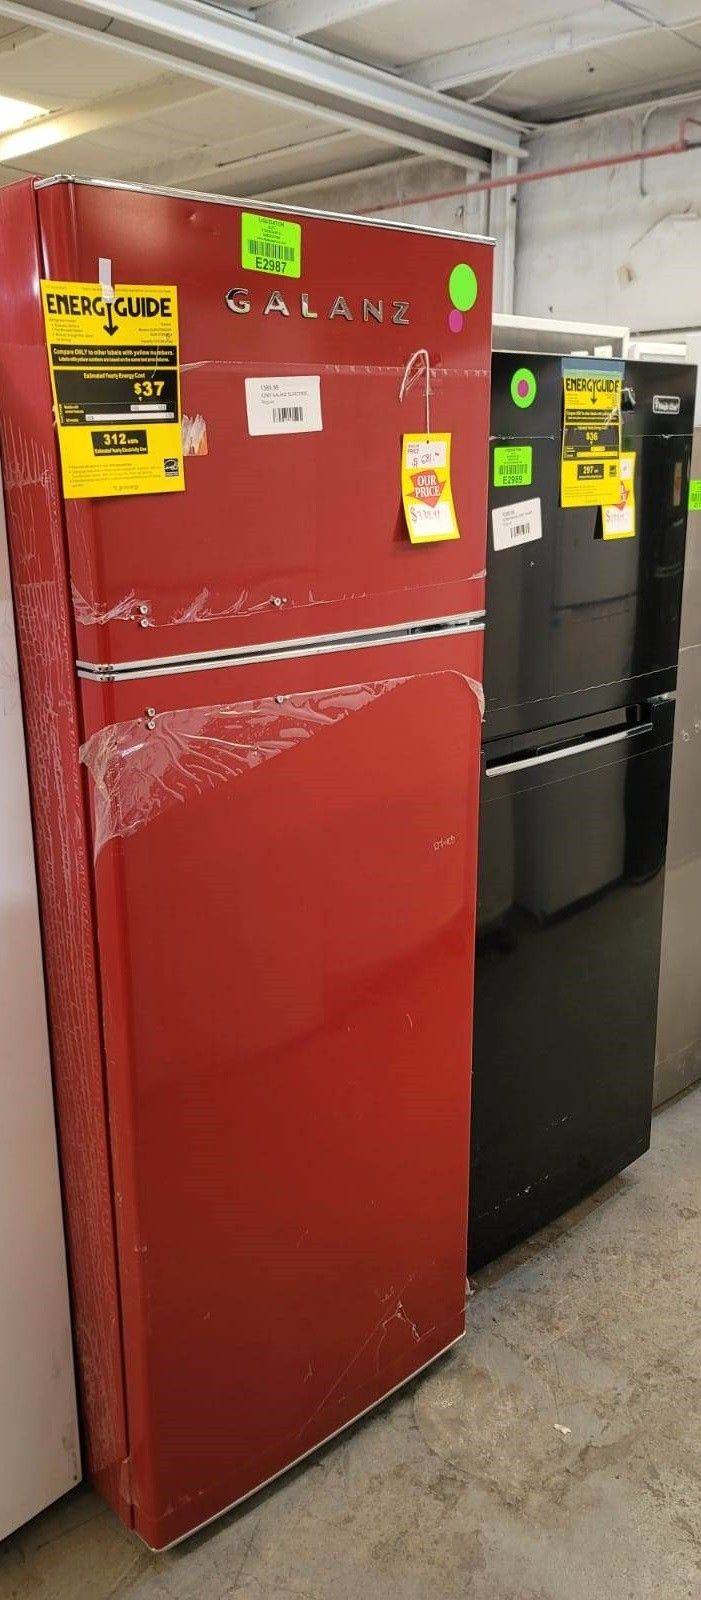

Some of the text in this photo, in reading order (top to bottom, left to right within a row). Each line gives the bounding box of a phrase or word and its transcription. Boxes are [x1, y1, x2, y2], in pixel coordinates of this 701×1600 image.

[255, 256, 287, 273] E2987
[225, 287, 411, 325] GALANZ
[133, 381, 165, 398] $37
[565, 378, 620, 393] ENERGYGUIDE
[103, 433, 127, 446] 312
[416, 475, 437, 487] OUR
[415, 485, 441, 498] PRICE
